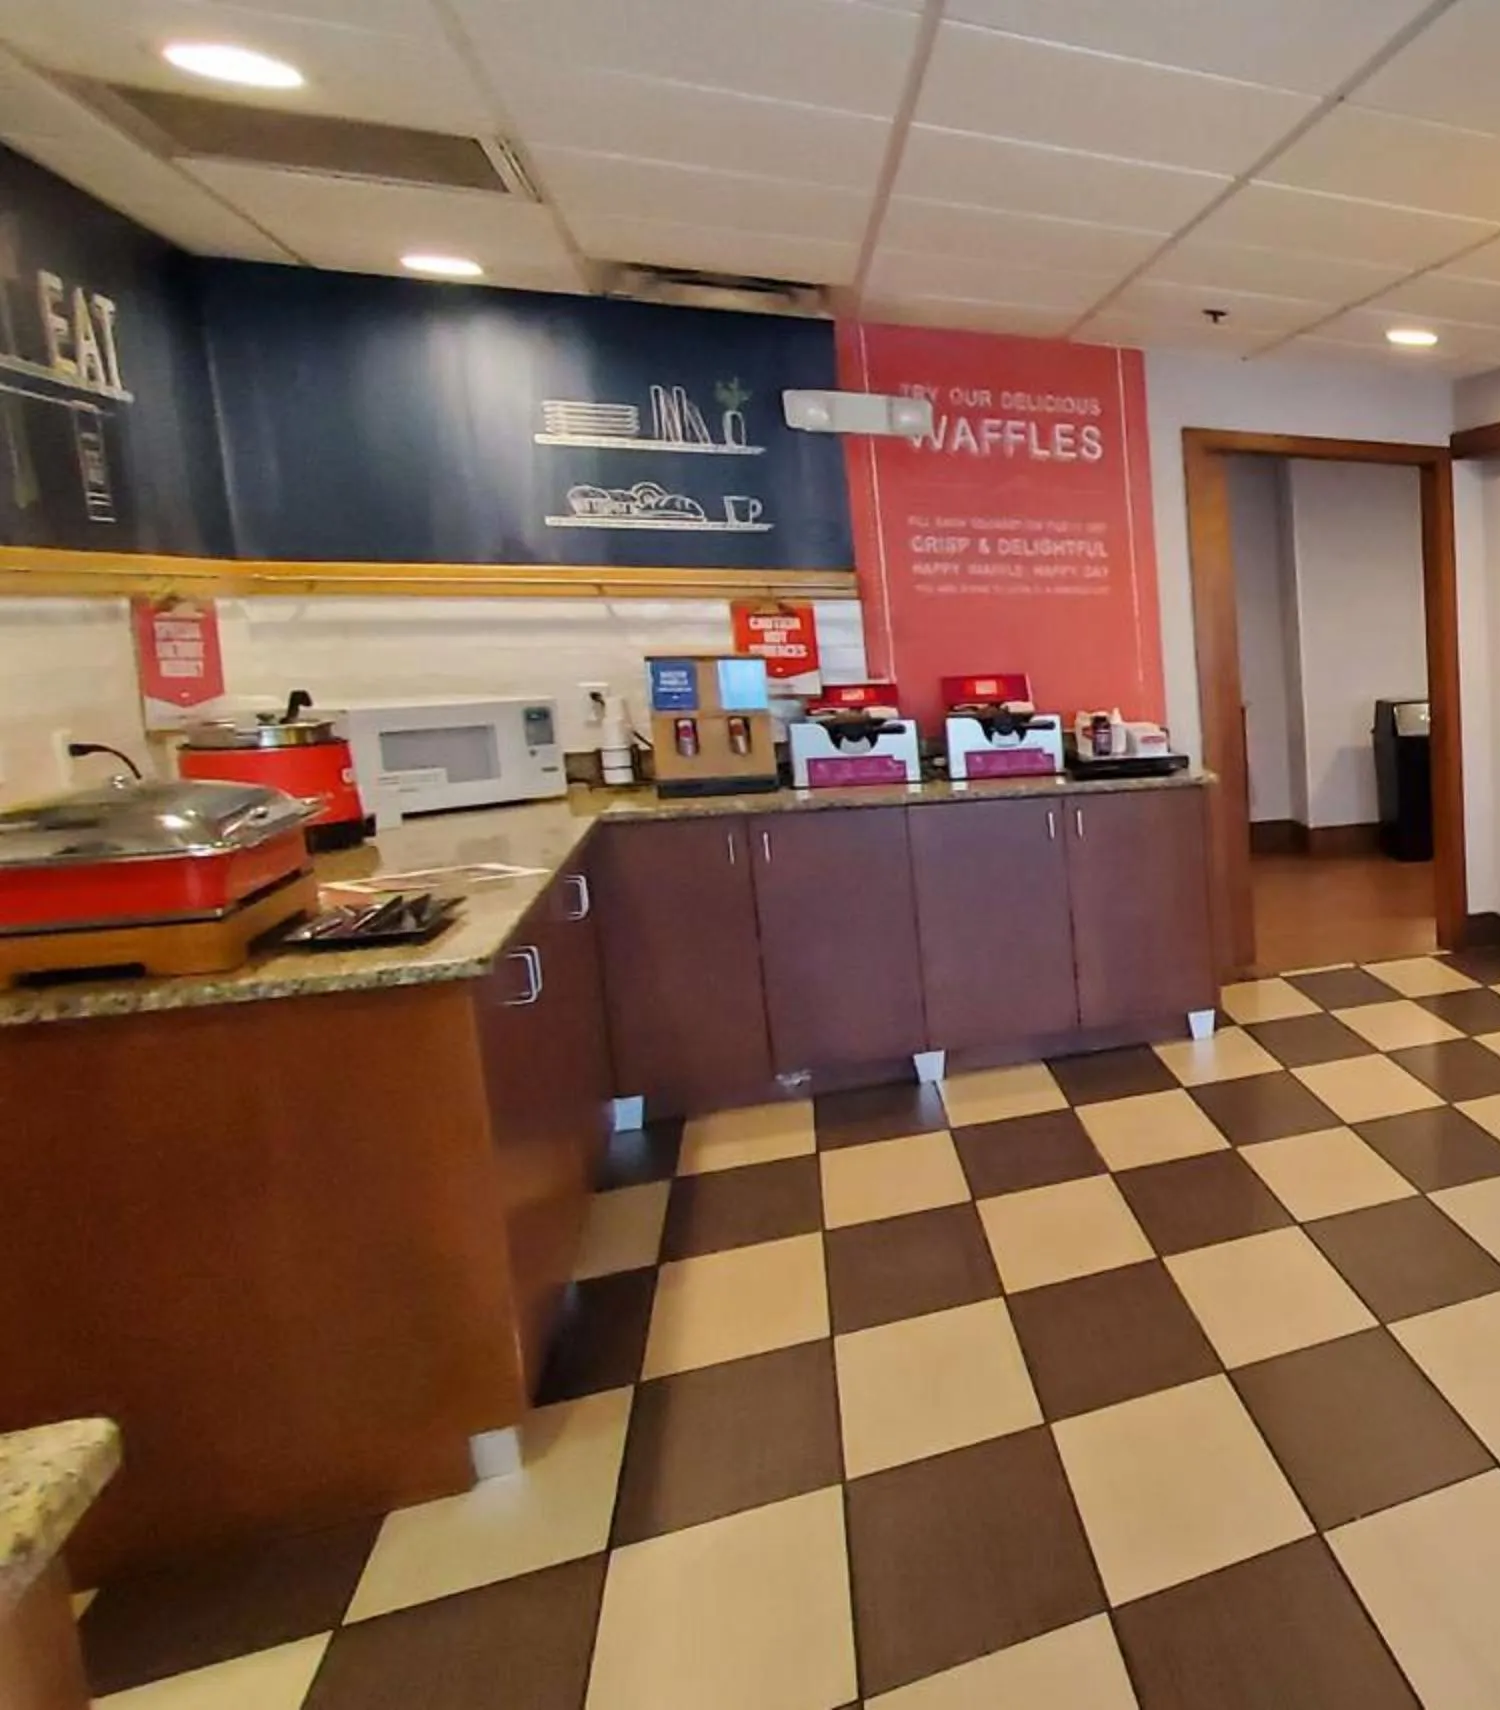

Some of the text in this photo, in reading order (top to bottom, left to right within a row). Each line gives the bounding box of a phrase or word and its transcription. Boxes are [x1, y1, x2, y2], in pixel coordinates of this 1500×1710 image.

[38, 269, 121, 391] EAT
[901, 384, 1102, 416] TRY OUR DELICIOUS
[908, 415, 1103, 460] WAFFLES
[911, 535, 1109, 558] CRISP & DELIGHTFUL
